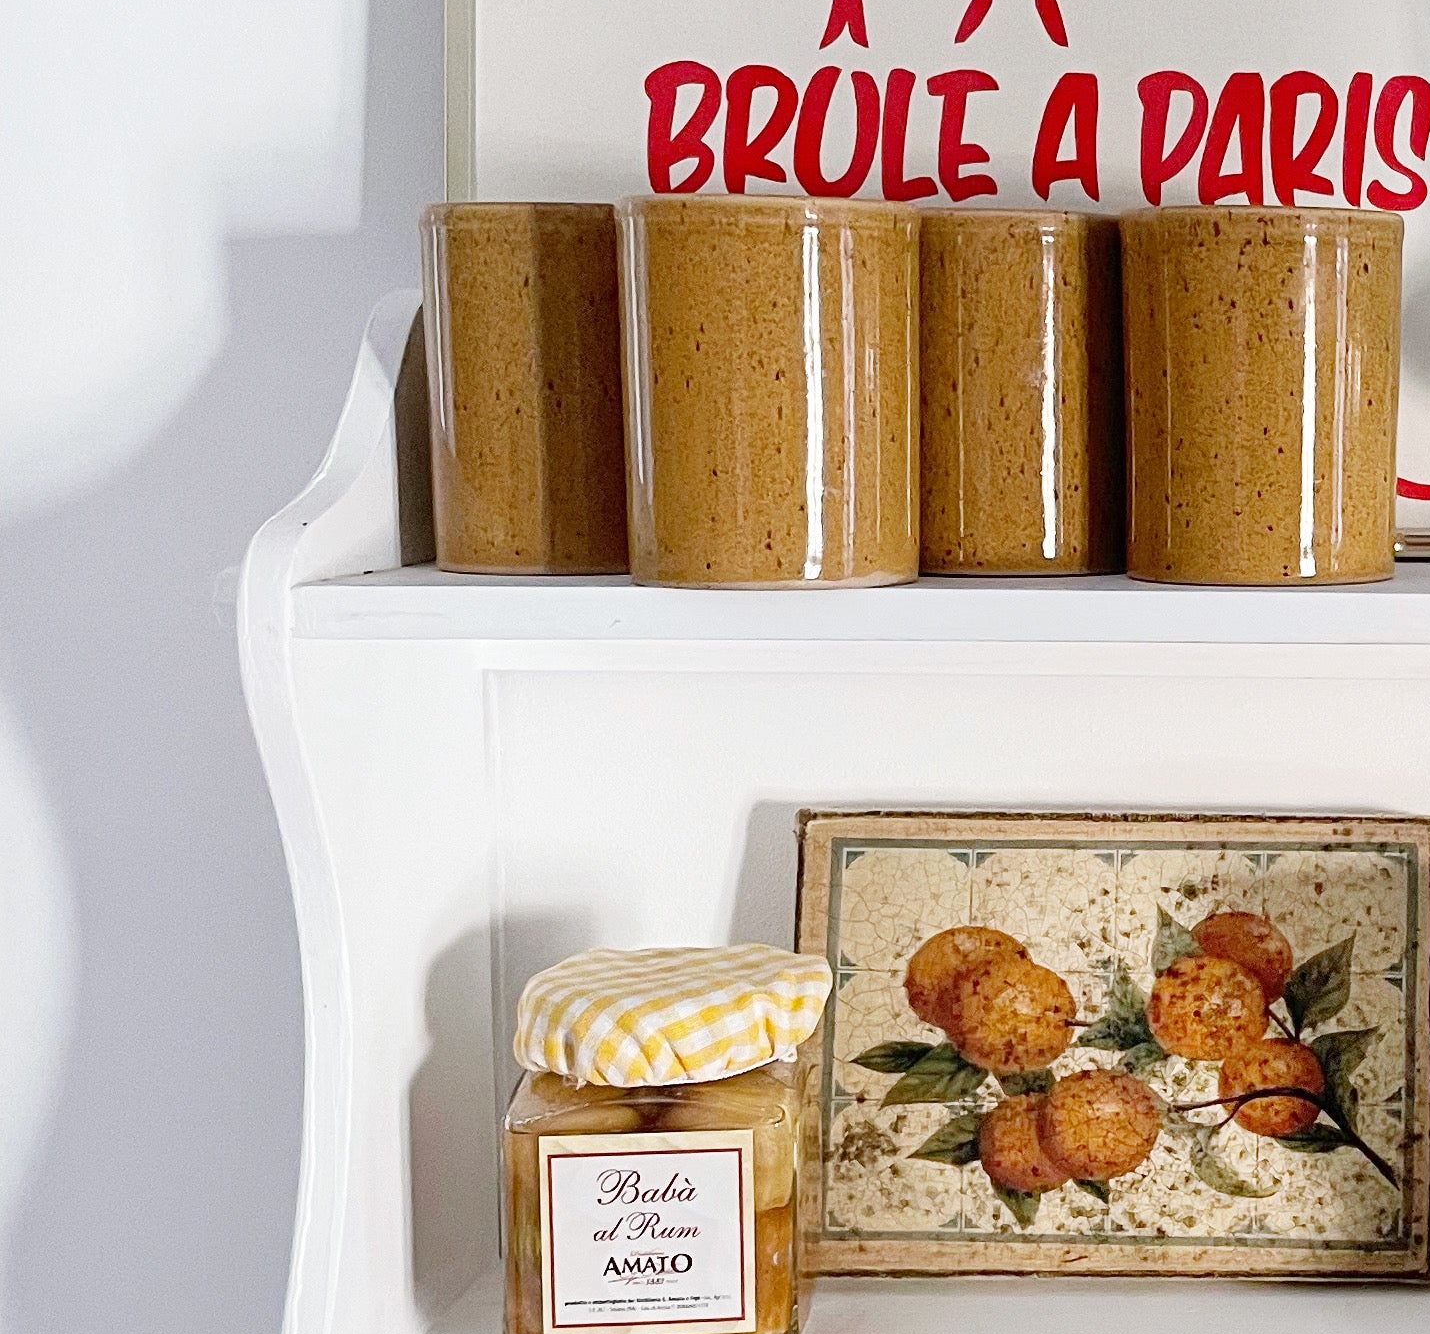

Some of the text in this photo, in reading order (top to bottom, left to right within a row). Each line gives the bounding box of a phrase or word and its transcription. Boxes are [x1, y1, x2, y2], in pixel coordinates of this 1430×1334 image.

[596, 1168, 698, 1206] Babà
[592, 1211, 701, 1243] al Rum
[602, 1253, 693, 1277] AMATO
